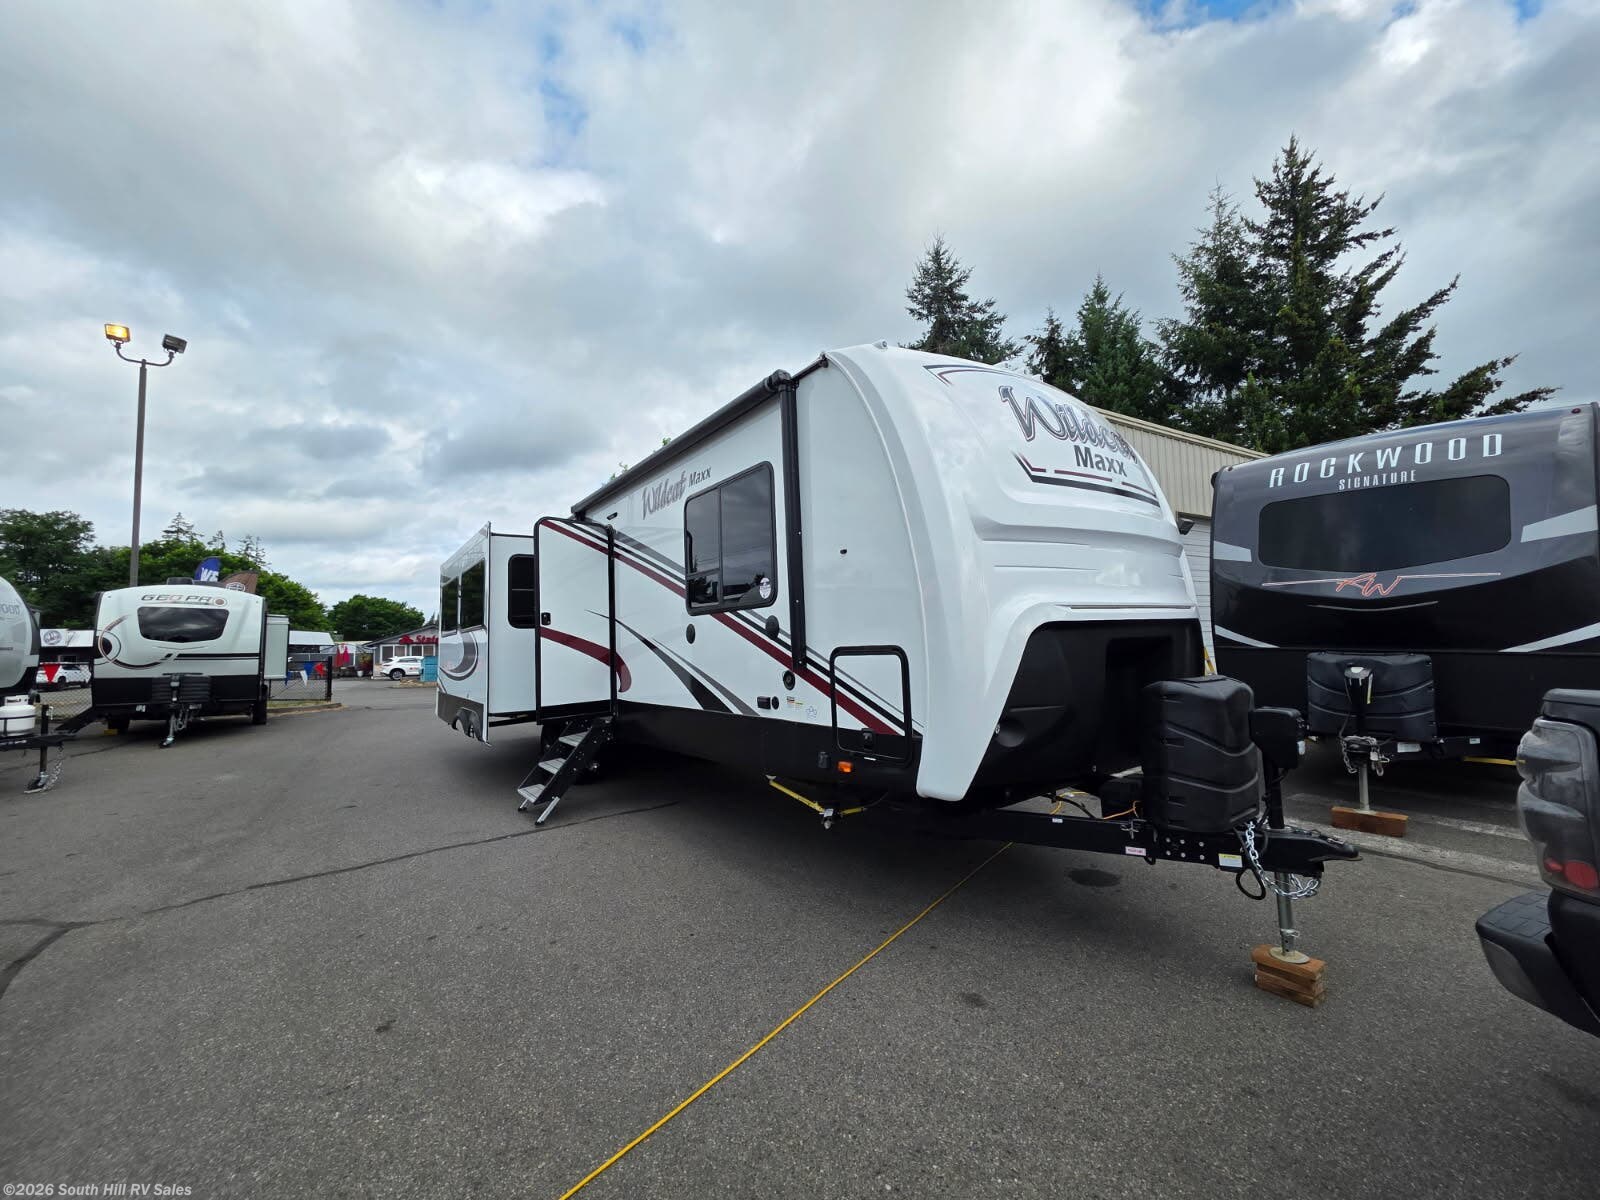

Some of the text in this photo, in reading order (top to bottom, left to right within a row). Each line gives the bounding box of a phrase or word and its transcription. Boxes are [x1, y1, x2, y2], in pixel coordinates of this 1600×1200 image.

[1073, 444, 1128, 477] Maxx
[1269, 433, 1503, 489] ROCKWOOD
[1338, 469, 1417, 491] SIGNATURE
[642, 467, 712, 521] Wildcat Maxx
